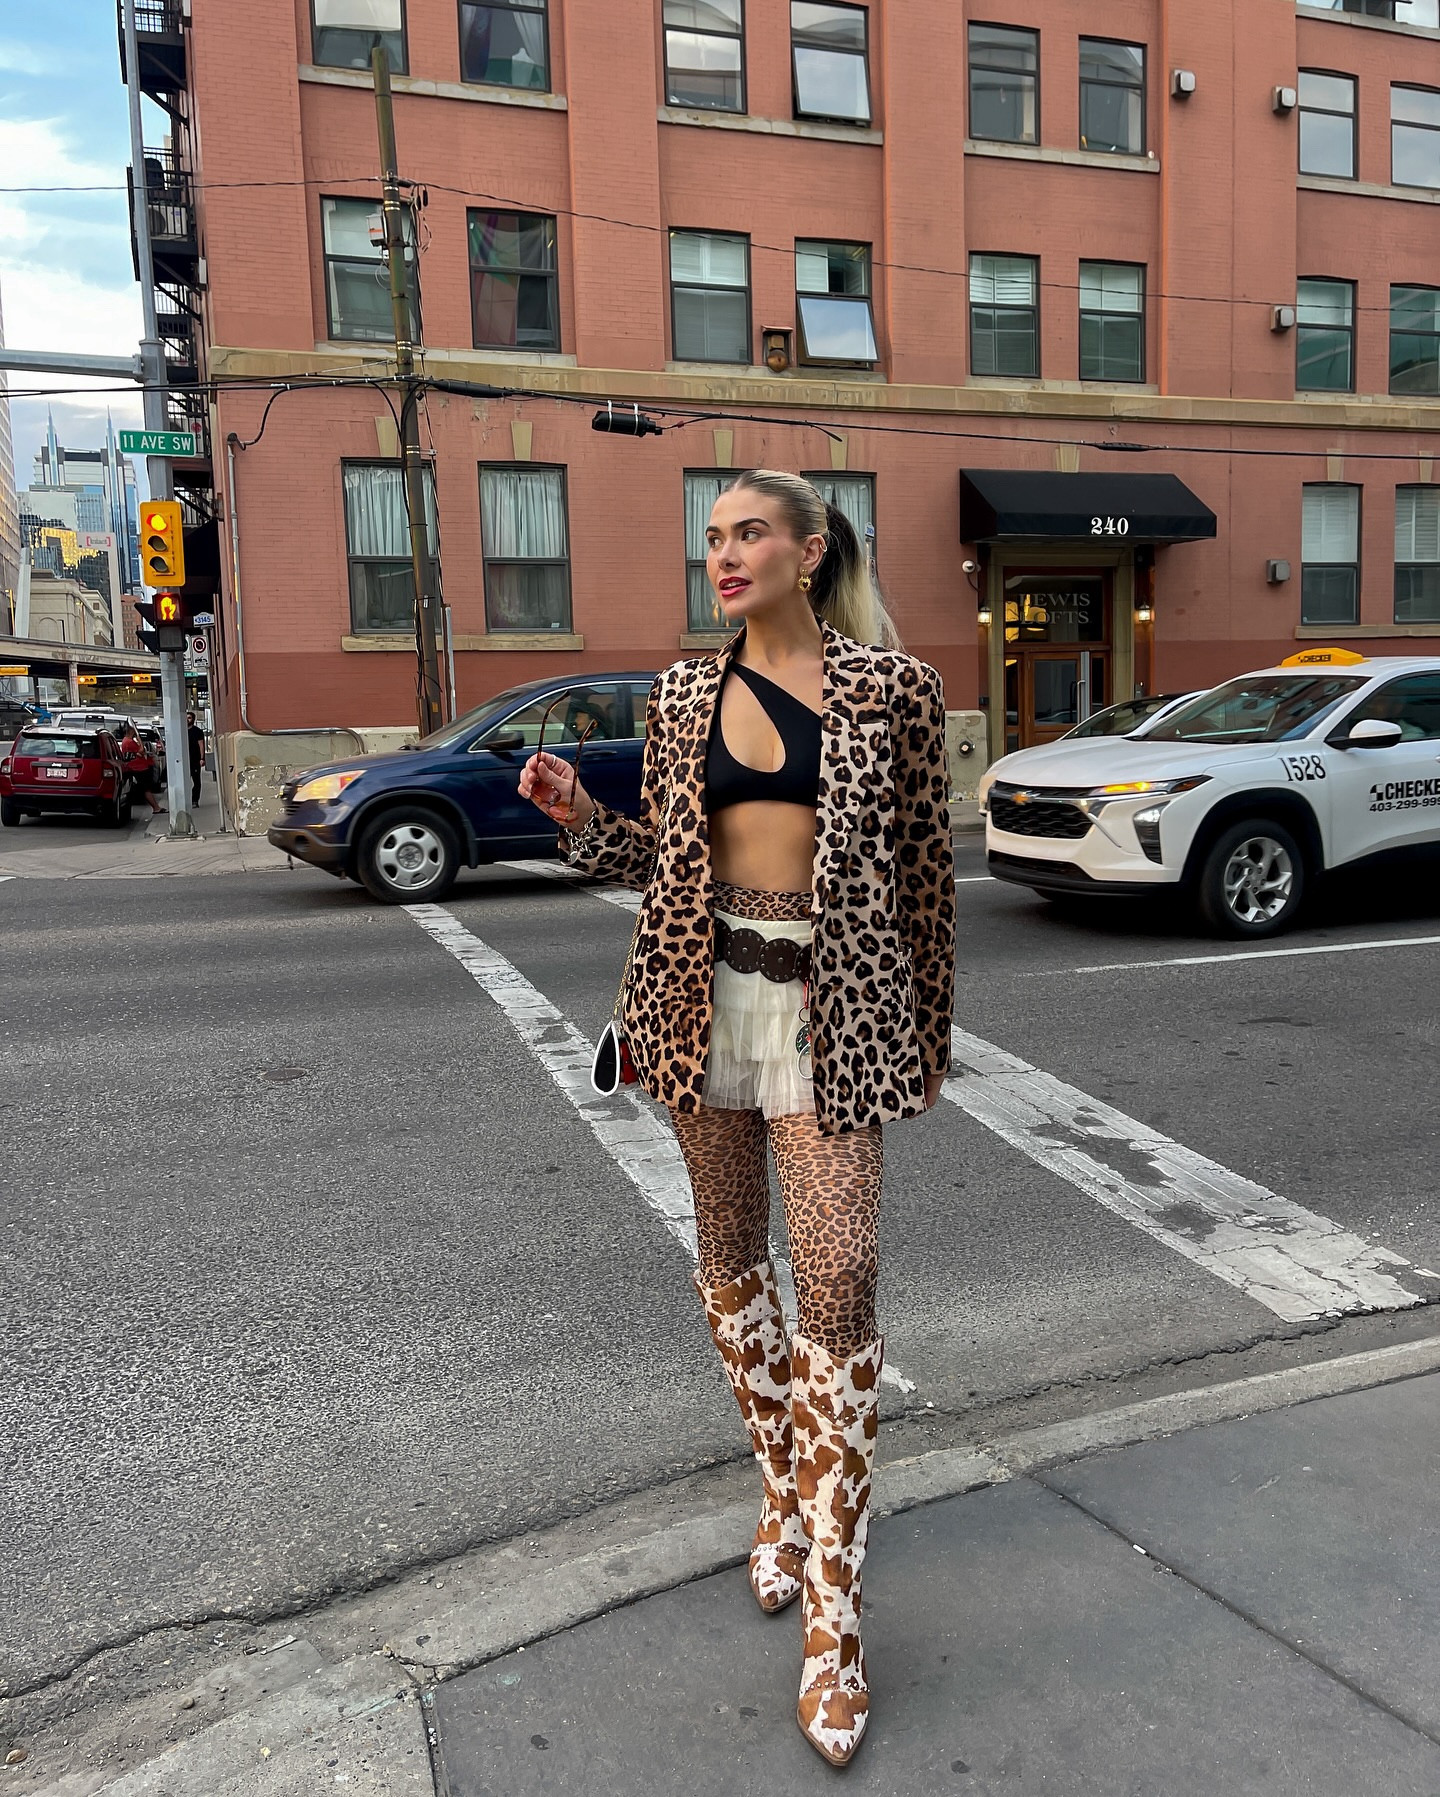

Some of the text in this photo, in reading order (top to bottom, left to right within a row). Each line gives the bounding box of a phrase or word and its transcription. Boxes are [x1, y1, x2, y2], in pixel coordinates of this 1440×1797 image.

[123, 434, 191, 451] 11 AVE SW
[1091, 517, 1129, 535] 240
[1018, 592, 1091, 607] LEWIS
[1020, 611, 1090, 625] LOFTS
[1277, 755, 1326, 782] 1528
